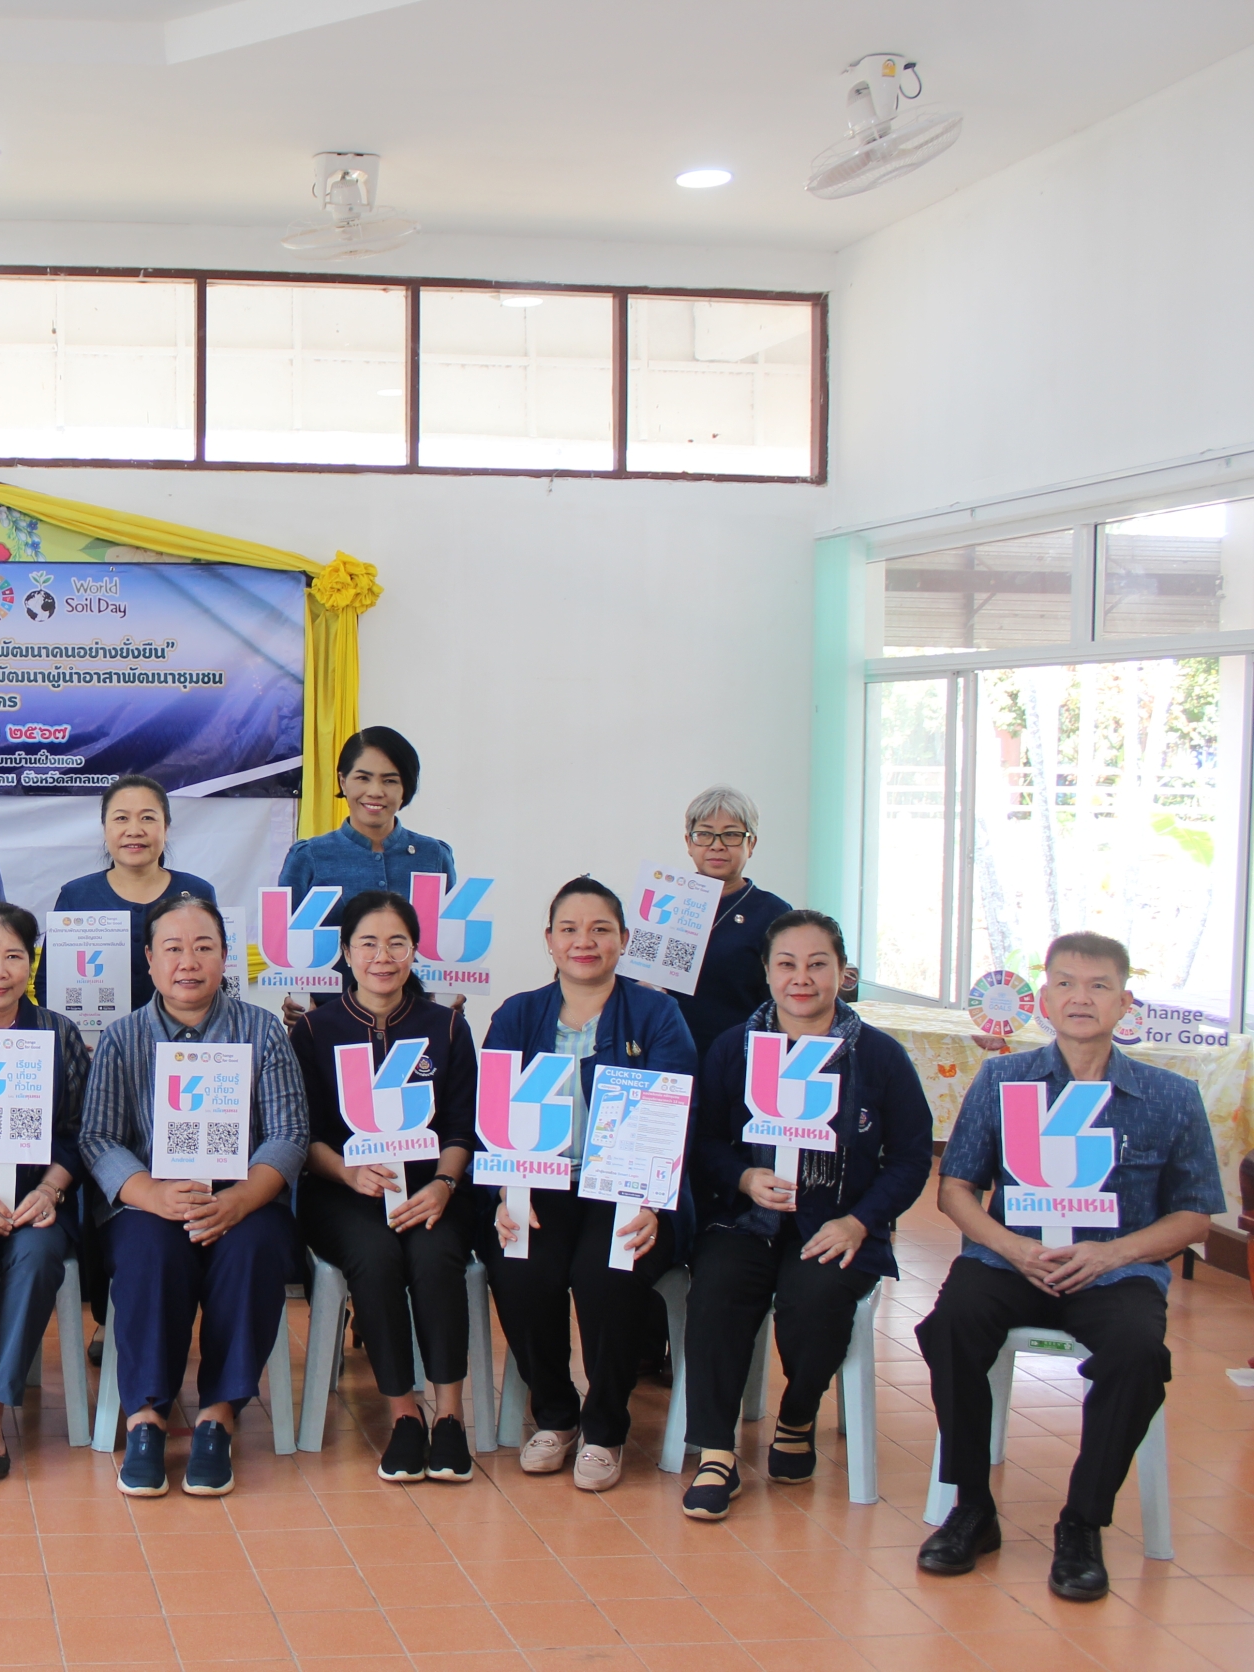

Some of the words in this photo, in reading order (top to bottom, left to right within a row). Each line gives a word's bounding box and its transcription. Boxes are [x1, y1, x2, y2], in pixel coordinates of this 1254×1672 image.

[72, 577, 119, 595] World
[65, 597, 94, 614] Soil
[98, 599, 127, 619] Day
[9, 725, 68, 740] ๒๕๖๗
[22, 772, 119, 785] จังหวัดสกลนคร
[683, 897, 708, 913] เรียนรู้
[672, 906, 679, 915] ดู
[681, 906, 700, 919] เที่ยว
[677, 916, 703, 930] ทั่วไทย
[261, 972, 339, 991] คลิกชุมชน
[1145, 1027, 1172, 1042] for
[1178, 1029, 1229, 1047] Good
[16, 1059, 43, 1072] เรียนรู้
[7, 1072, 13, 1082] ดู
[16, 1068, 37, 1080] เที่ยว
[213, 1073, 240, 1085] เรียนรู้
[606, 1069, 629, 1079] CLICK
[14, 1081, 42, 1092] ทั่วไทย
[204, 1086, 211, 1096] ดู
[213, 1082, 234, 1094] เที่ยว
[610, 1077, 650, 1088] CONNECT
[211, 1094, 240, 1106] ทั่วไทย
[748, 1120, 830, 1142] คลิกชุมชน
[348, 1137, 435, 1157] คลิกชุมชน
[475, 1154, 570, 1179] คลิกชุมชน
[1006, 1192, 1115, 1218] คลิกชุมชน
